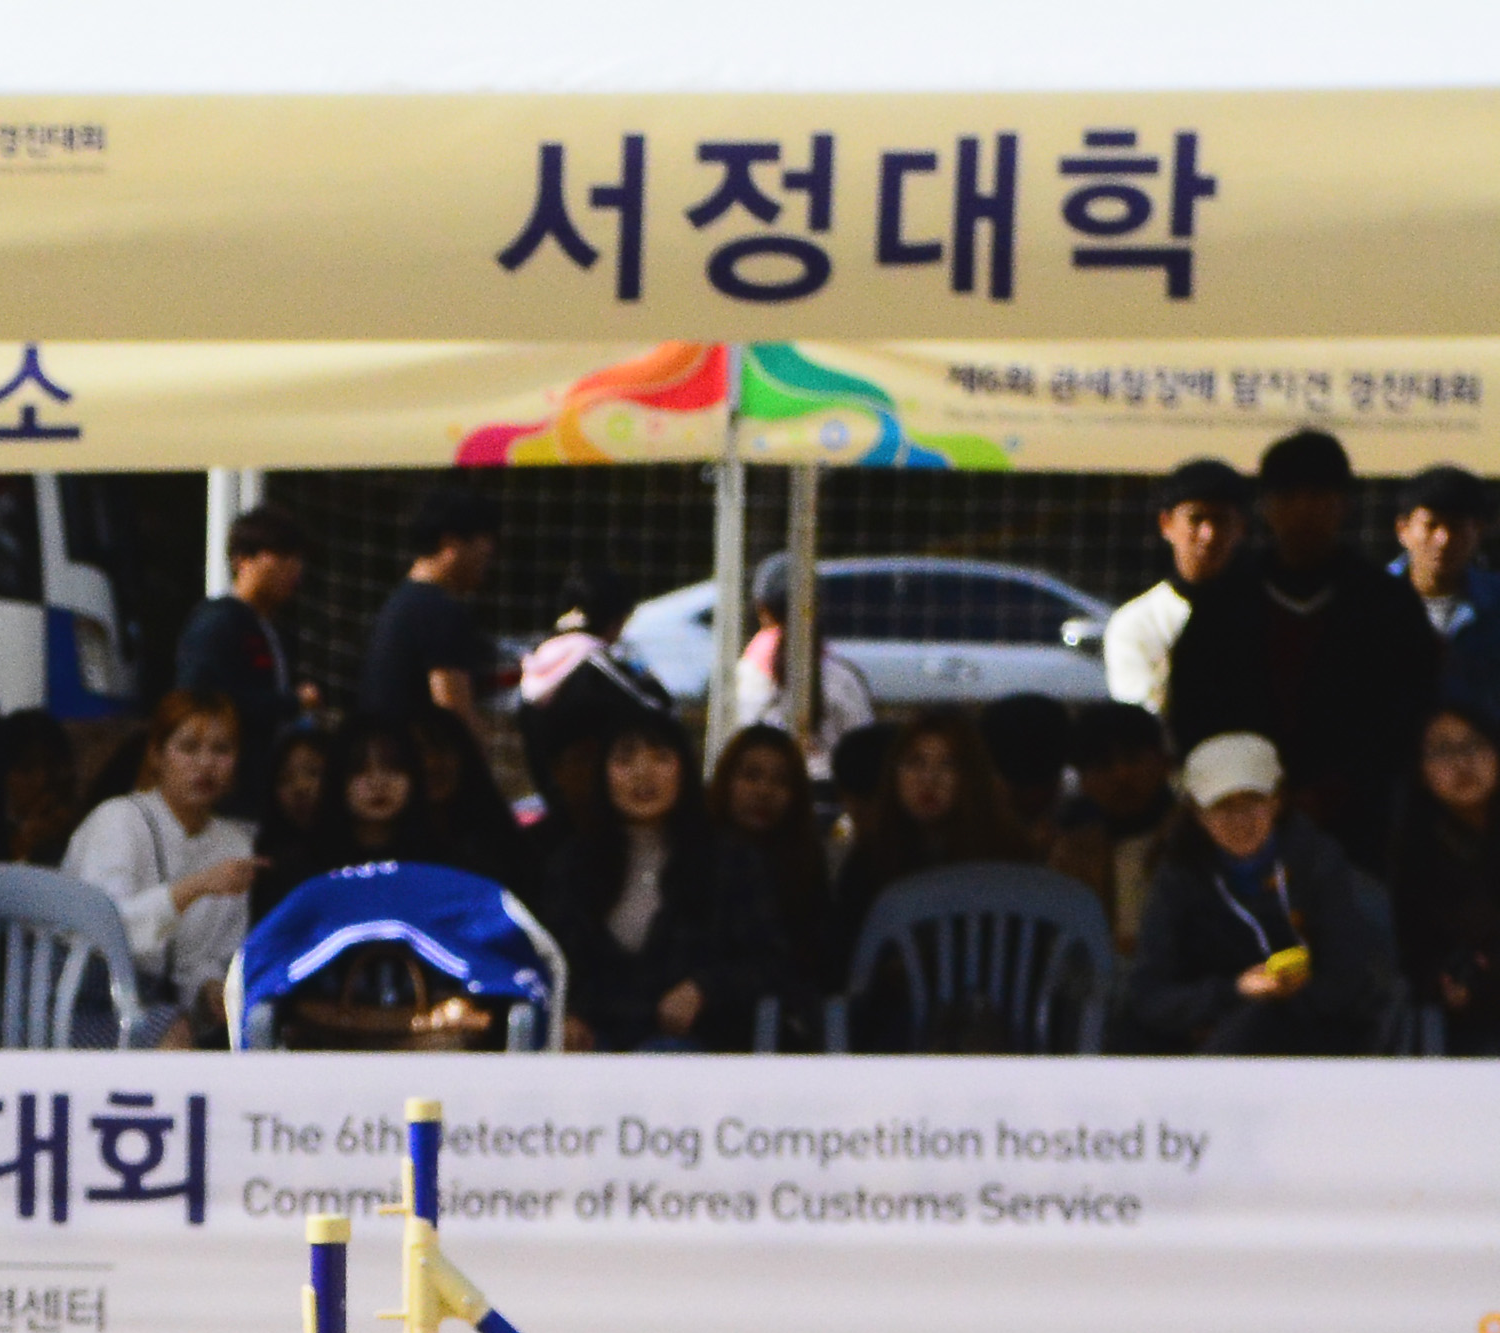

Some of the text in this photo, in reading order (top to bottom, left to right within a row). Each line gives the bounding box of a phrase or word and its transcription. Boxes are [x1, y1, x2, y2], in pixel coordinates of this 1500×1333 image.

[497, 127, 1217, 303] 서정대학
[243, 1114, 1209, 1173] The 6th etector Dog Competition hosted by
[242, 1177, 1142, 1226] Commiioner of Korea Customs Service
